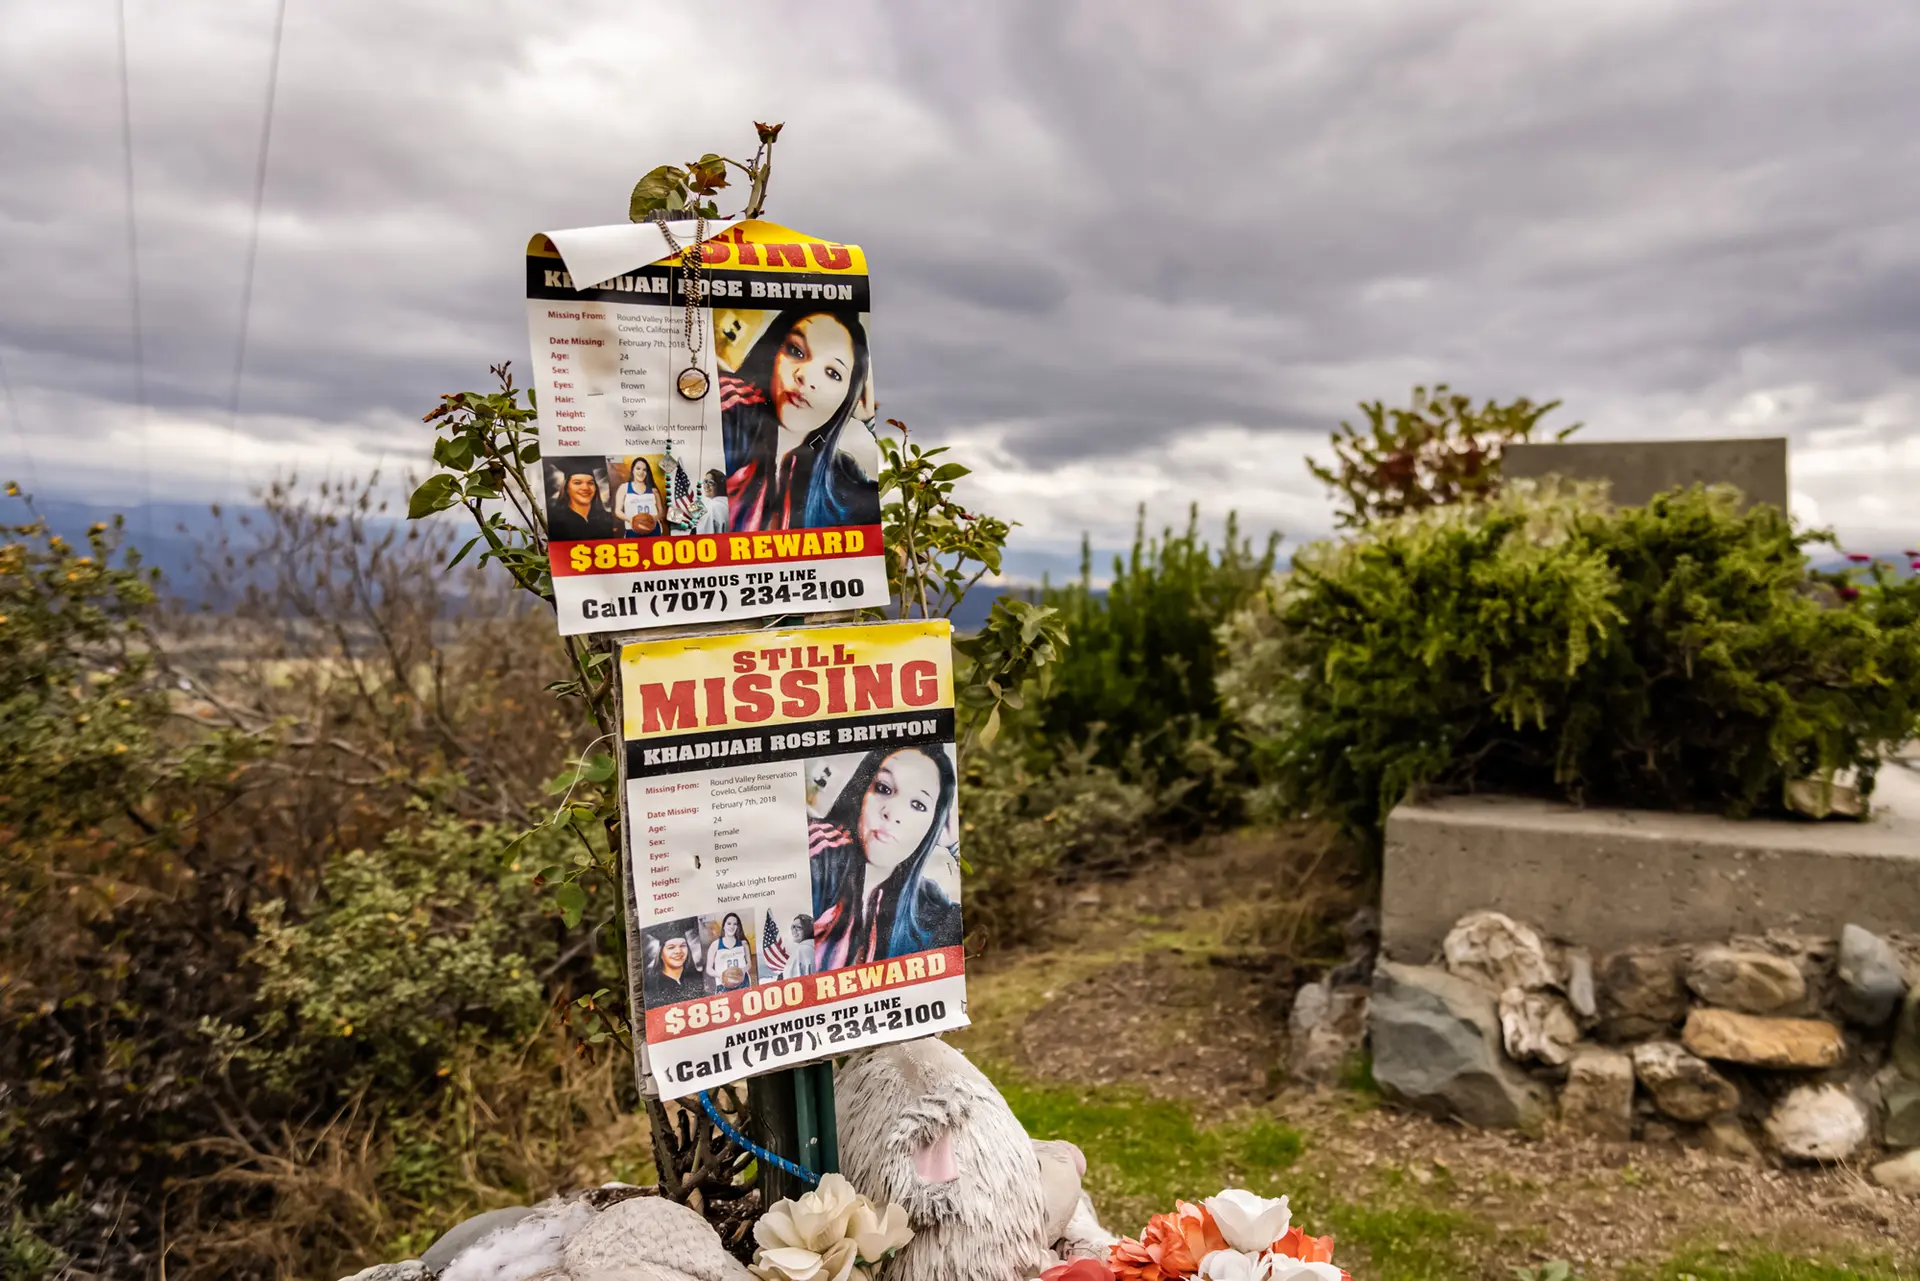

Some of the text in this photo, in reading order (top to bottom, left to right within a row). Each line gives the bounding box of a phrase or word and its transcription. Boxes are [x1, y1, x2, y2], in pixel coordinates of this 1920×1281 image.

[750, 281, 853, 300] BRITTON
[548, 311, 606, 321] Missing From:
[617, 313, 641, 322] Round
[642, 315, 663, 324] Valley
[618, 325, 680, 335] Covelo, California
[549, 337, 605, 347] Date Missing:
[619, 338, 652, 348] February
[653, 340, 666, 348] 7th,
[551, 352, 570, 361] Age:
[619, 353, 630, 361] 24
[552, 366, 570, 374] Sex:
[620, 367, 647, 376] Female
[553, 381, 574, 390] Eyes:
[620, 381, 646, 390] Brown
[554, 395, 575, 404] Hair:
[621, 396, 647, 404] Brown
[556, 410, 586, 419] Height:
[556, 424, 587, 433] Tattoo:
[623, 424, 708, 433] Wailacki (right forearm)
[558, 438, 581, 447] Race:
[625, 438, 650, 446] Native
[569, 530, 865, 572] $85,000 REWARD
[631, 568, 817, 594] ANONYMOUS TIP LINE
[581, 578, 865, 619] Call (707) 234-2100
[733, 644, 855, 673] STILL
[640, 660, 939, 734] MISSING
[643, 719, 938, 766] KHADIJAH ROSE BRITTON
[710, 770, 798, 786] Round Valley Reservation
[645, 782, 700, 795] Missing From:
[710, 783, 772, 797] Covelo, California
[711, 796, 777, 811] February 7th, 2018
[647, 806, 699, 819] Date Missing:
[713, 816, 722, 824] 24
[648, 825, 667, 834] Age:
[713, 828, 740, 837] Female
[649, 839, 666, 847] Sex:
[714, 842, 738, 850] Brown
[649, 852, 670, 861] Eyes:
[714, 855, 738, 863] Brown
[650, 865, 670, 873] Hair:
[651, 877, 680, 888] Height:
[716, 872, 798, 890] Wailacki (right forearm)
[653, 891, 680, 901] Tattoo:
[717, 889, 776, 904] Native American
[664, 952, 947, 1035] $85,000 REWARD
[725, 996, 901, 1049] ANONYMOUS TIP LINE
[675, 1000, 947, 1082] Call (707) 234-2100
